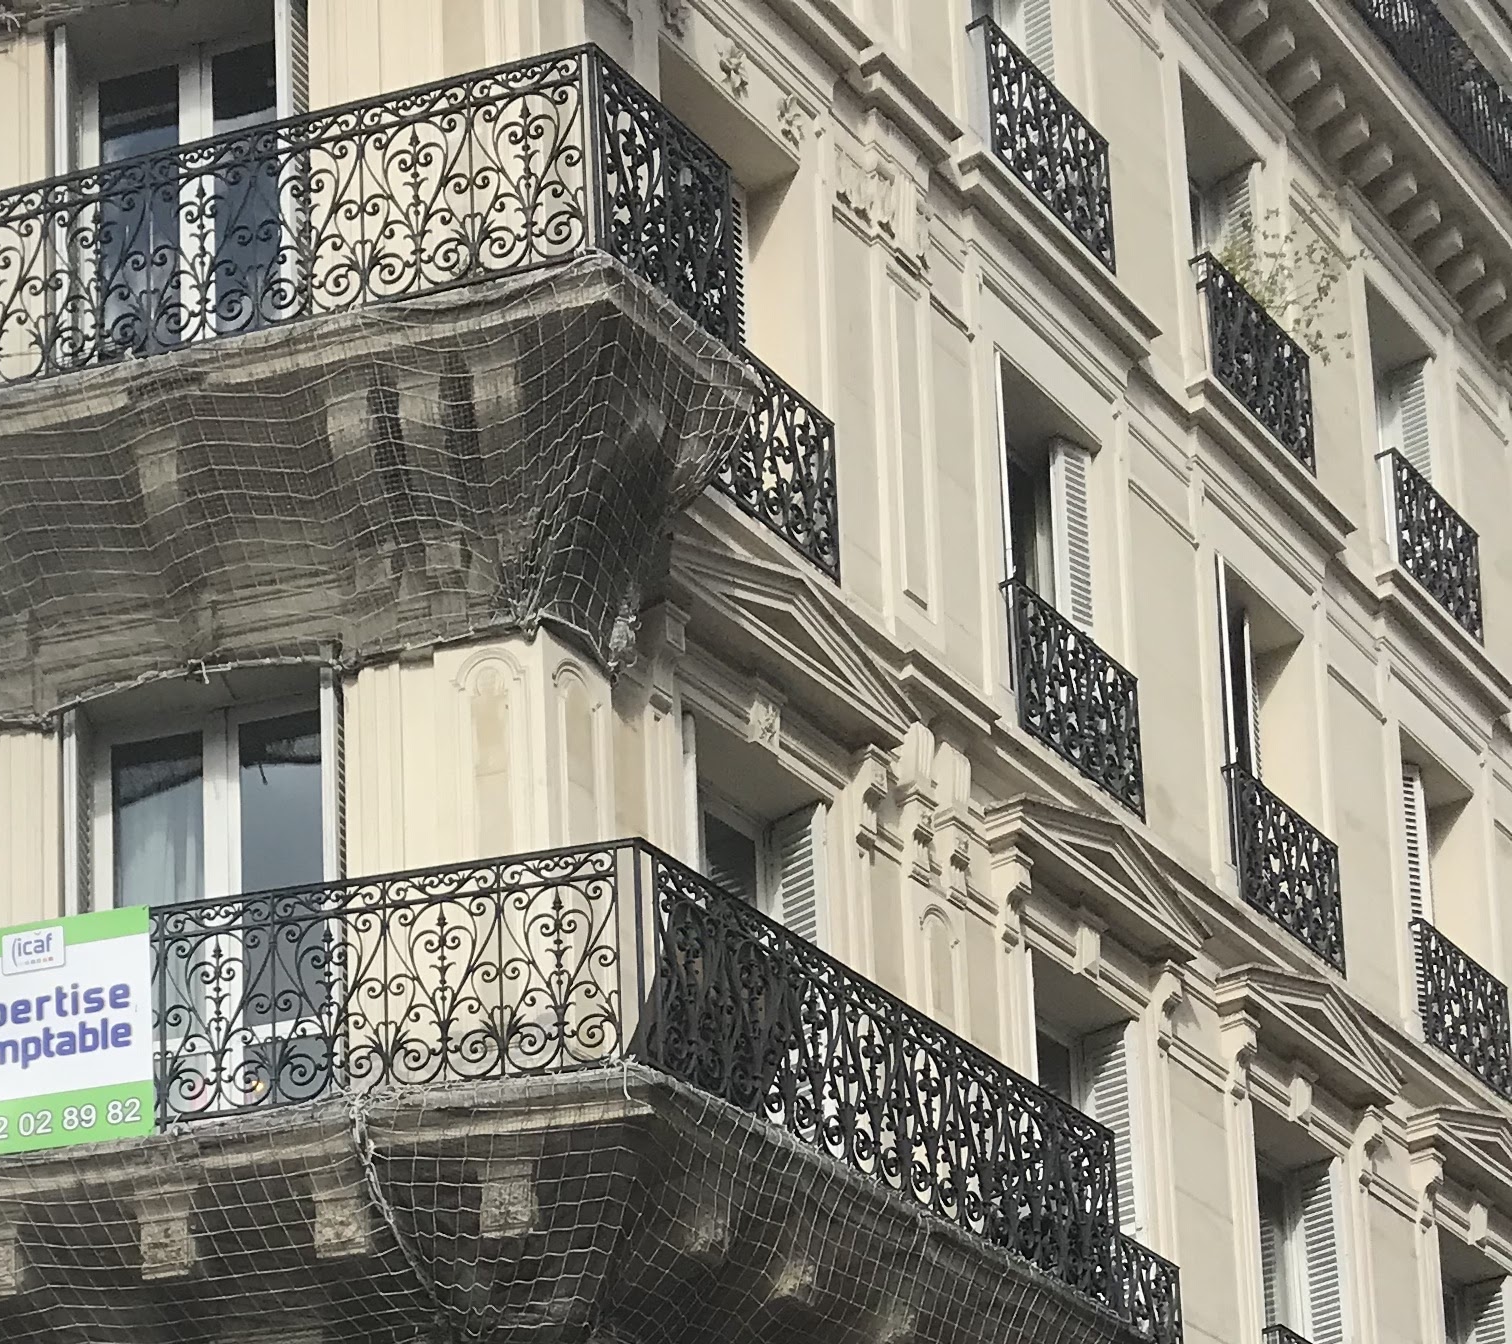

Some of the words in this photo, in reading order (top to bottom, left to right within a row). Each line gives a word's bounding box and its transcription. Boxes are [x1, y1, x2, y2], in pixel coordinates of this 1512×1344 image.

[18, 1110, 53, 1137] 02
[63, 1104, 97, 1131] 89
[106, 1097, 142, 1124] 82
